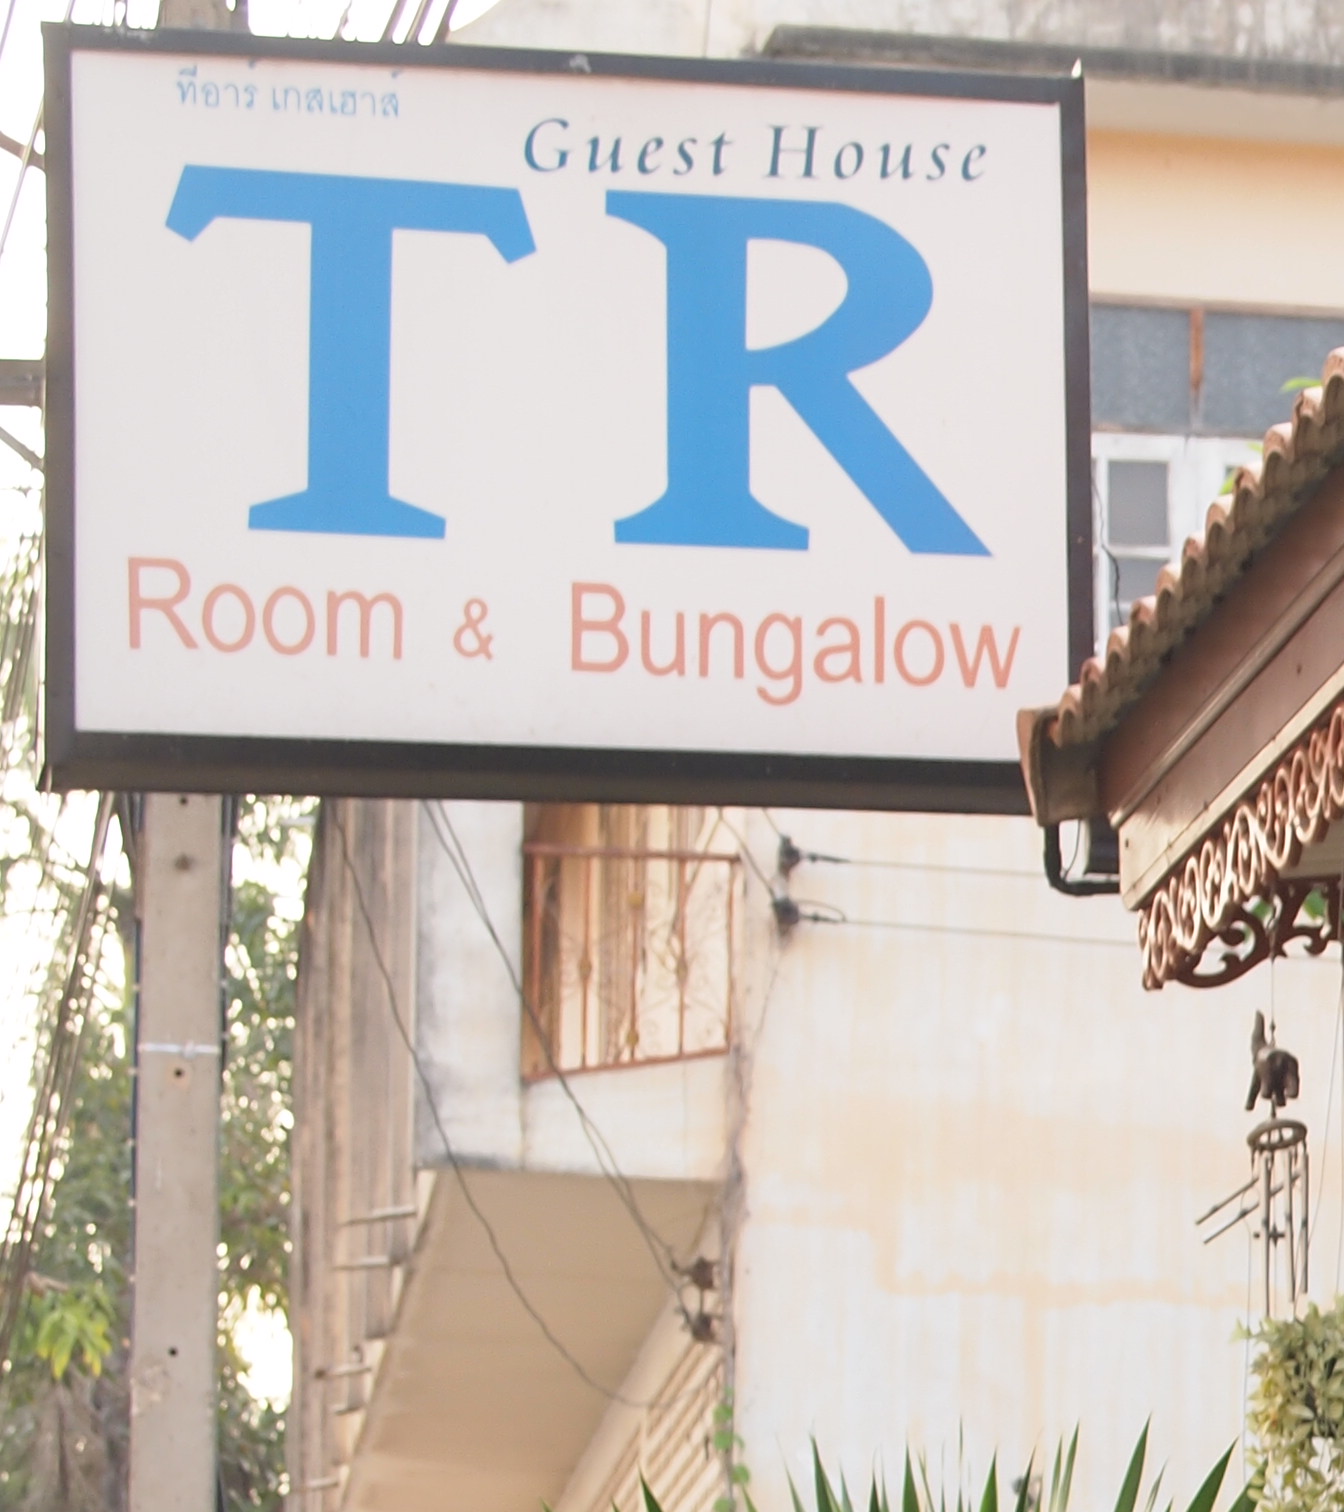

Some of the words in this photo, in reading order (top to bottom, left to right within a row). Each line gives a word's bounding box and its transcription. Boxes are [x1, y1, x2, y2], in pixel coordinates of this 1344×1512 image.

[523, 118, 733, 177] Guest
[763, 123, 988, 183] House
[127, 555, 404, 661] Room
[453, 597, 494, 661] &
[571, 580, 1022, 706] Bungalow
